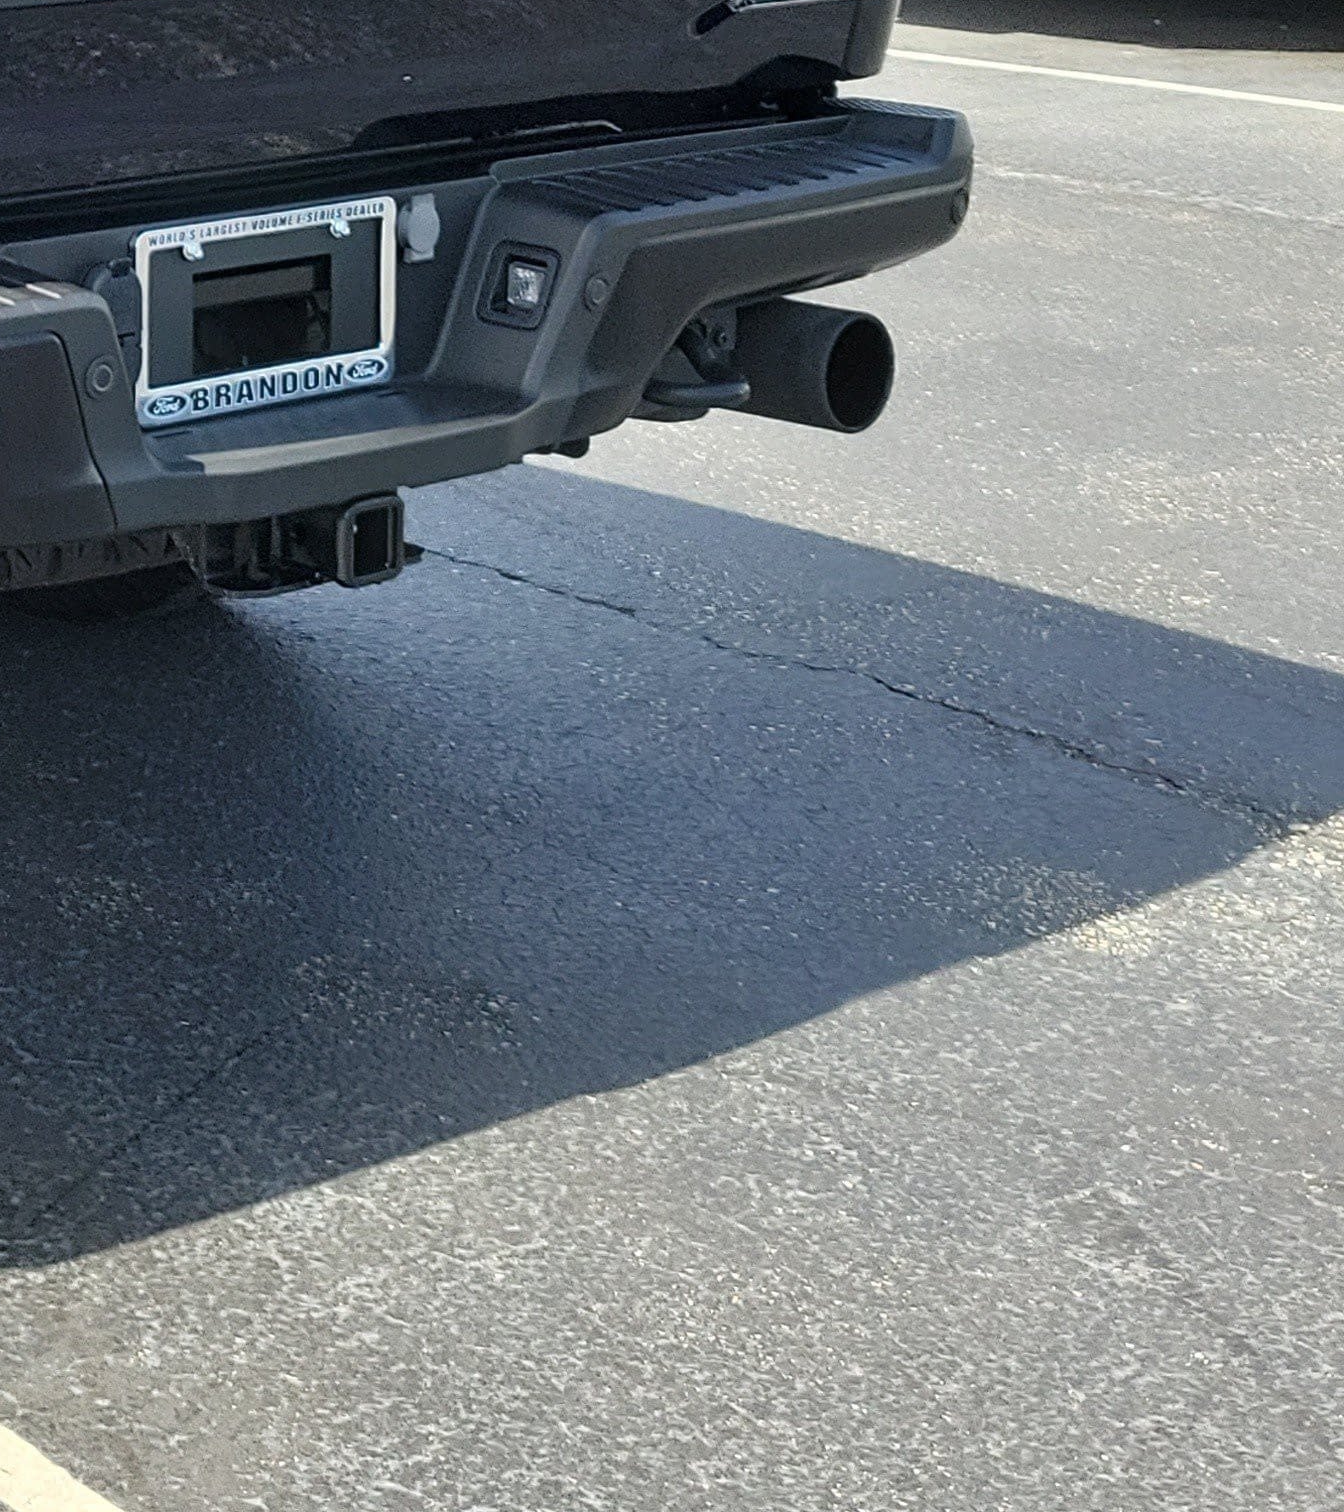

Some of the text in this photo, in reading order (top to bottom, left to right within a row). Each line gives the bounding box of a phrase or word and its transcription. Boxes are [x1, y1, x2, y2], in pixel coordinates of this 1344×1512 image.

[147, 201, 385, 247] WORLD'S LARGEST VOLUME F-SERIES DEALER
[190, 362, 344, 411] BRANDON
